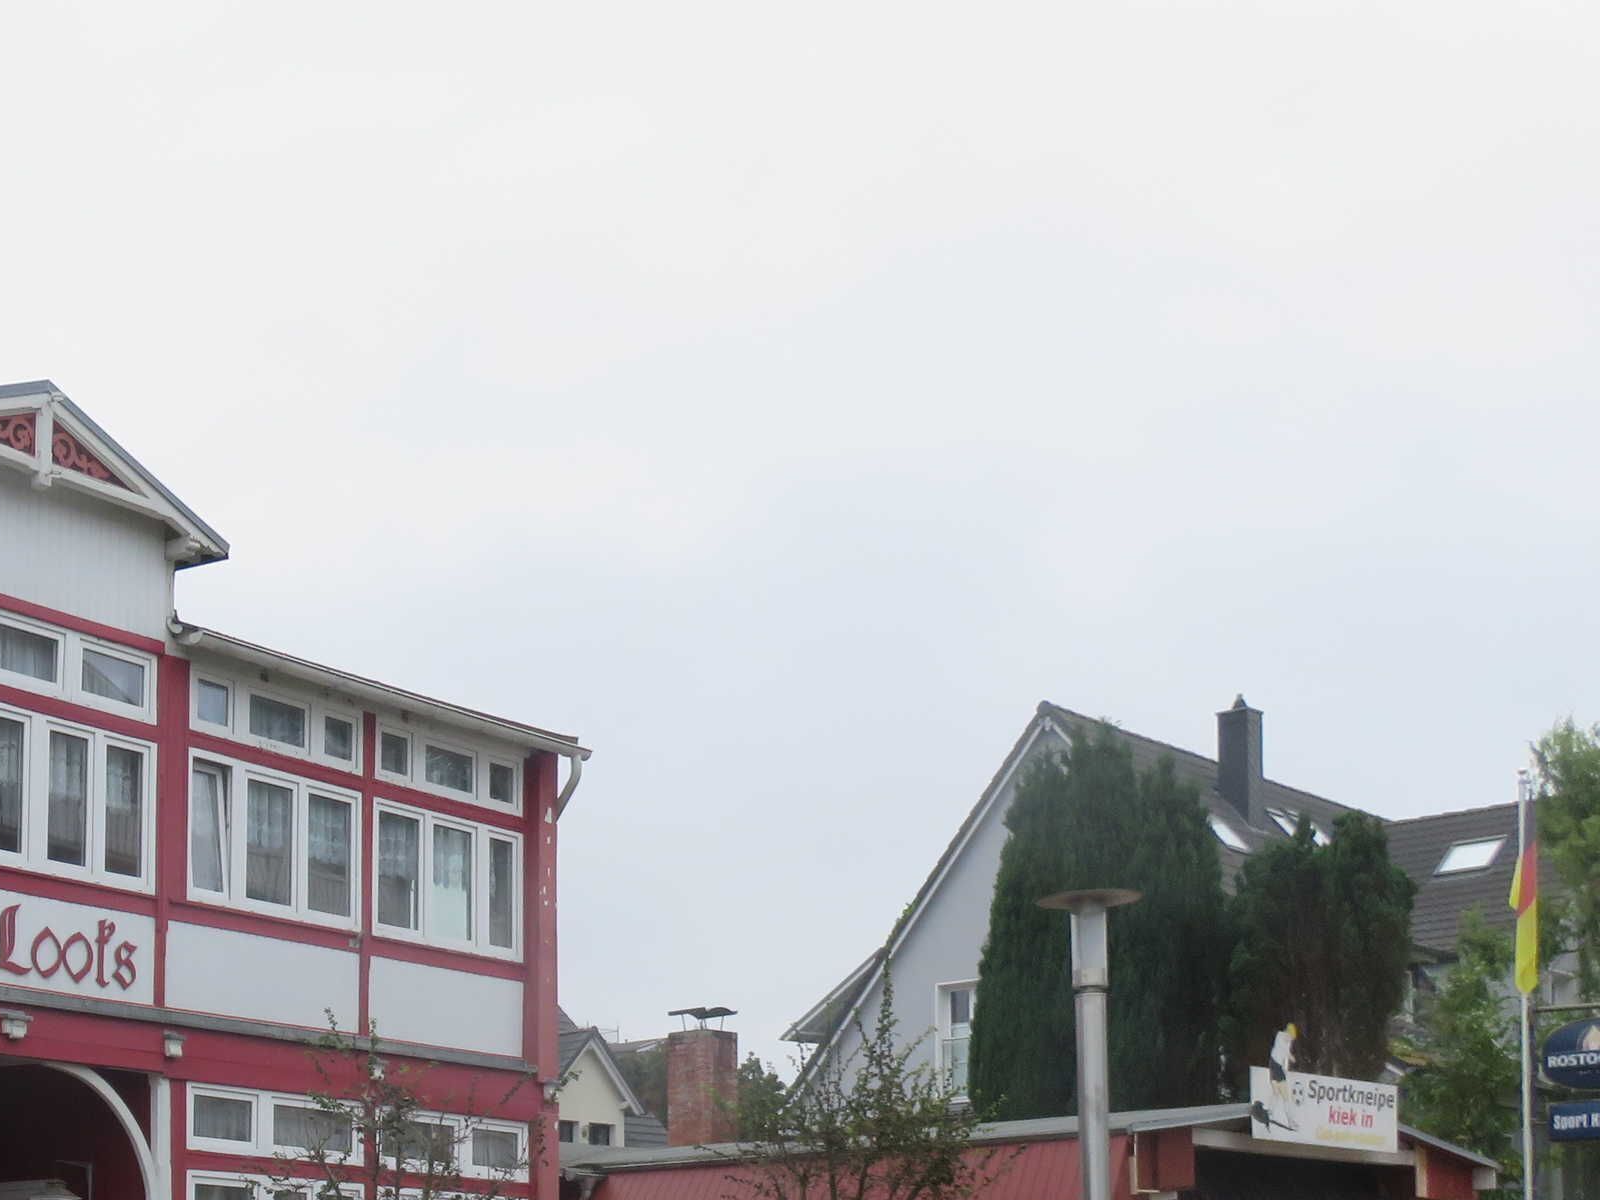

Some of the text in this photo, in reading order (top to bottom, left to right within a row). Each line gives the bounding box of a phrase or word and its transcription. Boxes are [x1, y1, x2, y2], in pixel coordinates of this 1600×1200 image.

[1547, 1052, 1600, 1068] ROSTO
[1308, 1080, 1395, 1112] Sportkneipe
[1328, 1105, 1374, 1128] kiek in
[1553, 1114, 1588, 1130] Sport
